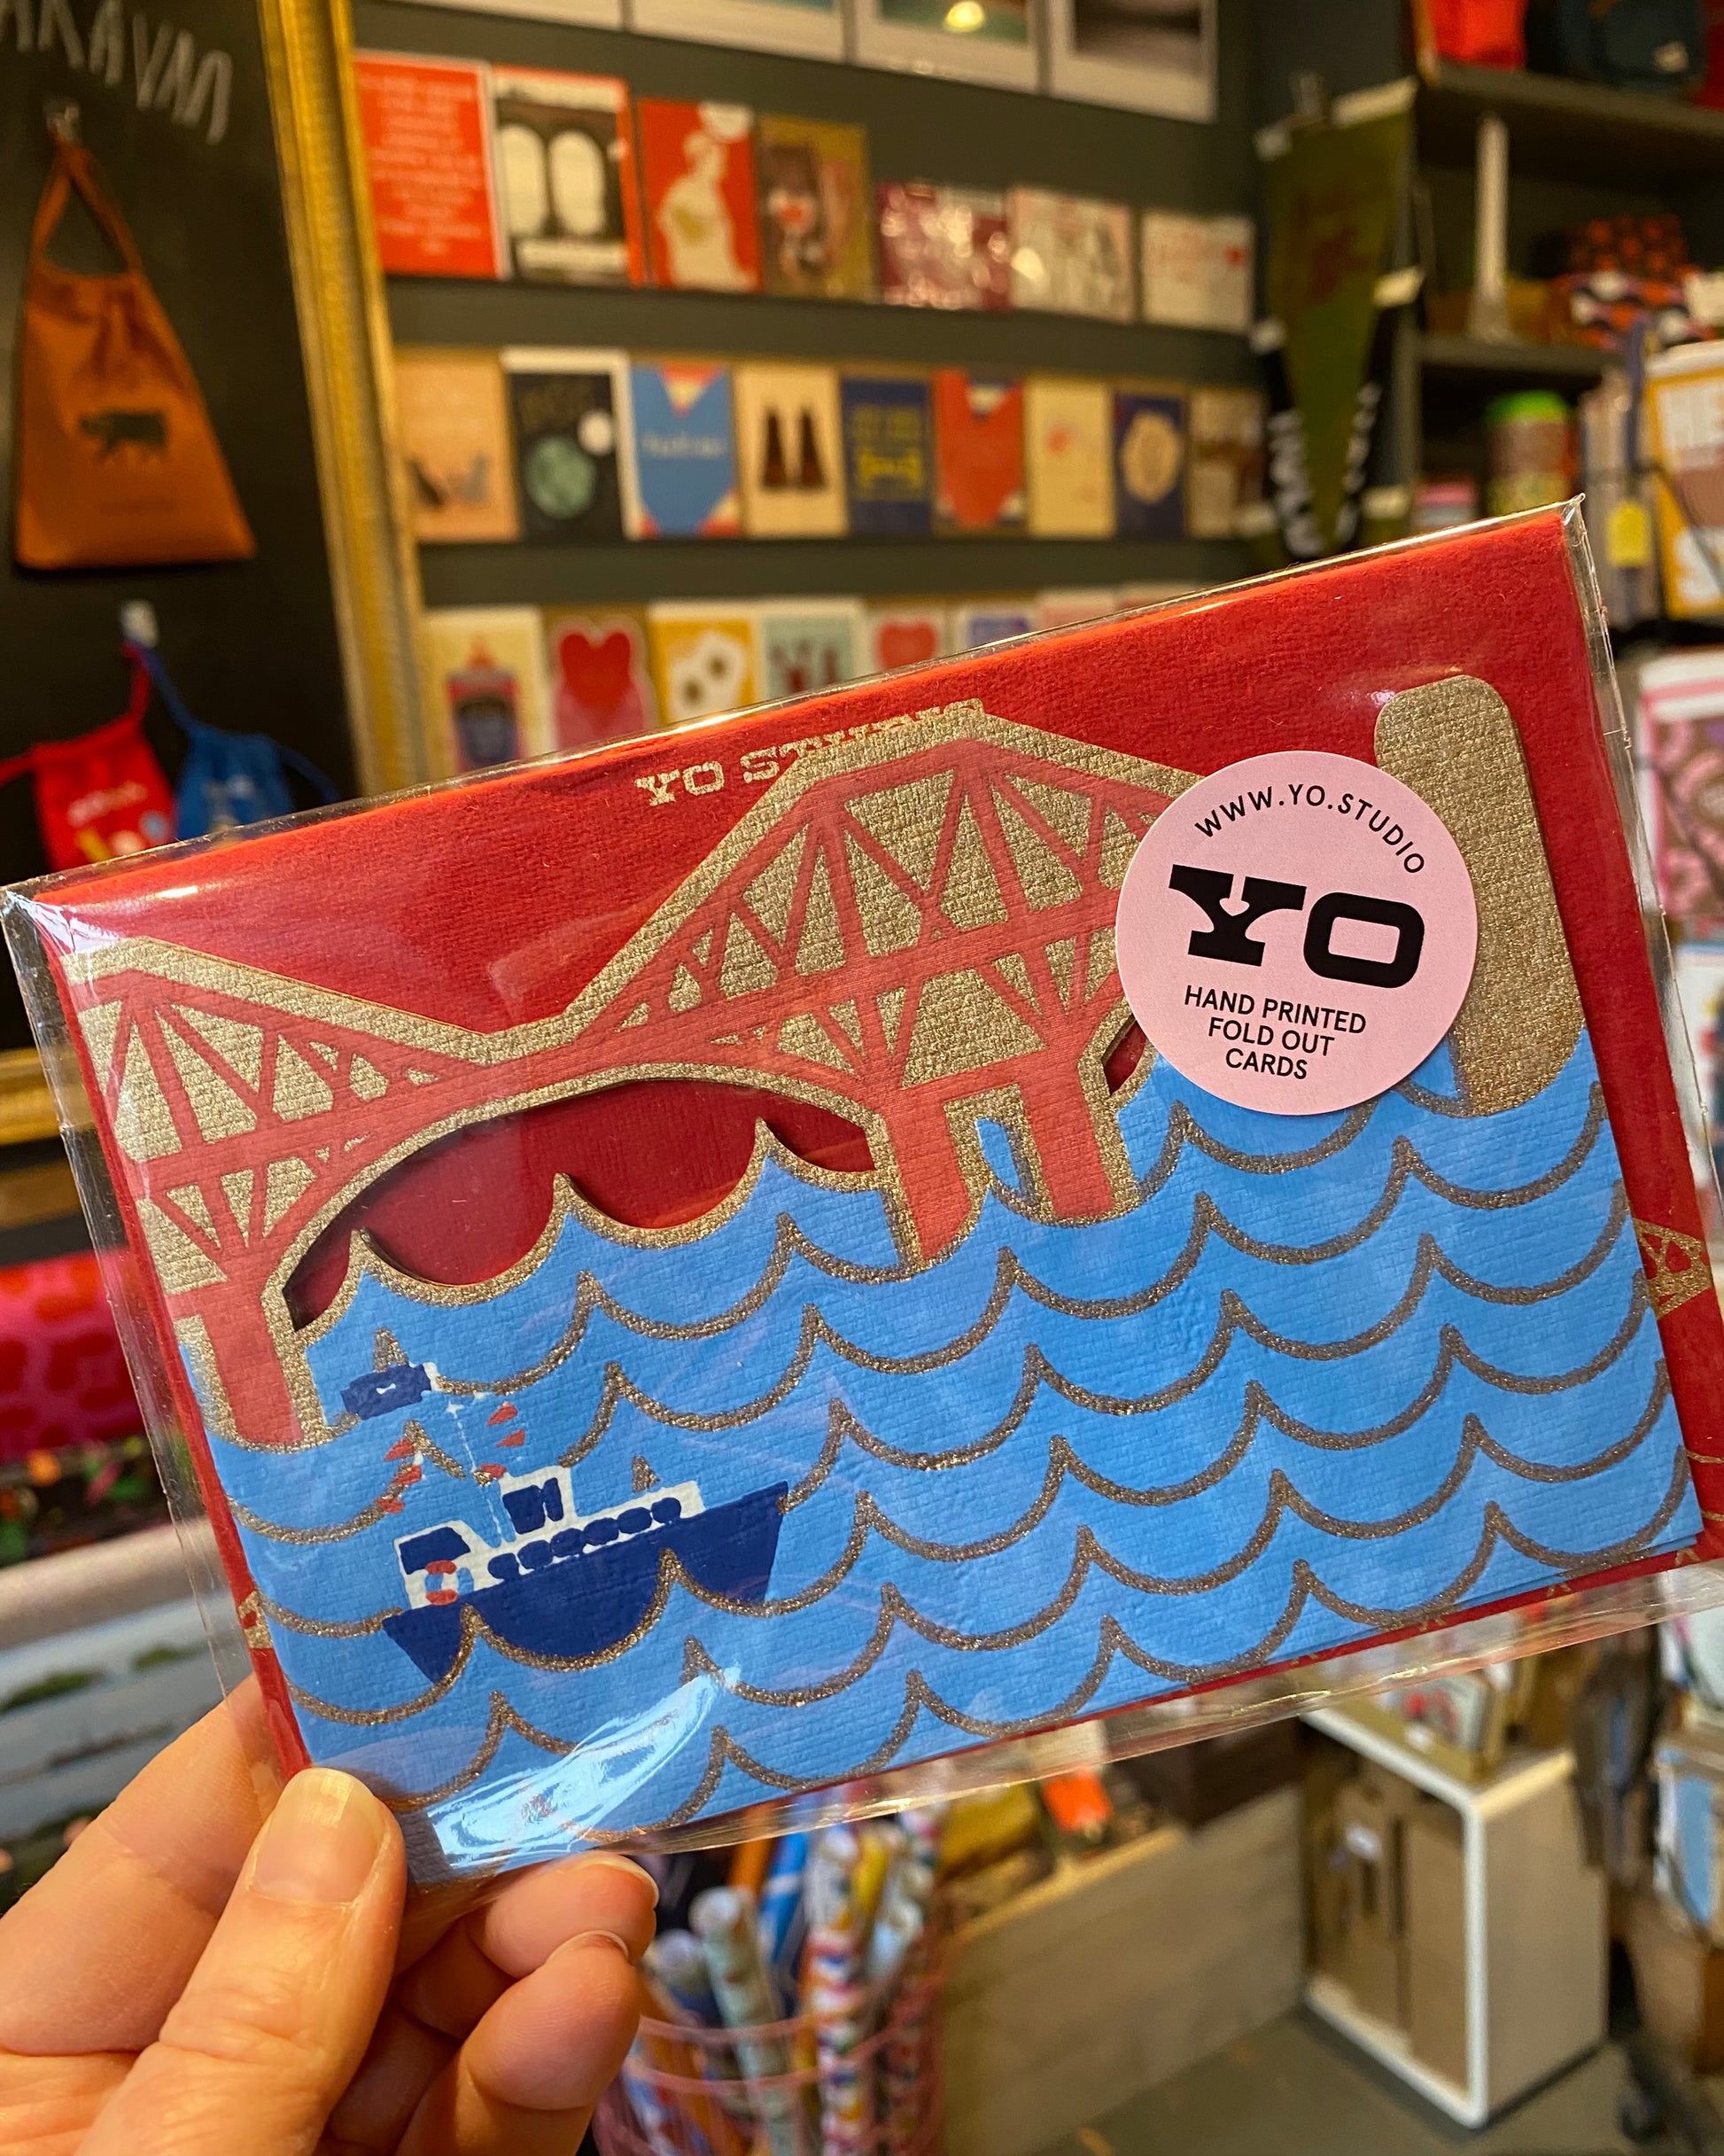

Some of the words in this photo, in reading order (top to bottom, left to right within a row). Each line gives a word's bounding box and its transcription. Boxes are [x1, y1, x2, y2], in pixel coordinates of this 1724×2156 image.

[634, 760, 725, 806] YO
[1194, 783, 1425, 874] WWW.YO.STUDIO
[1169, 864, 1425, 989] YO
[1184, 985, 1254, 1015] HAND
[1262, 998, 1367, 1034] PRINTED
[1208, 1017, 1274, 1046] FOLD
[1282, 1031, 1335, 1056] OUT
[1225, 1047, 1308, 1080] CARDS
